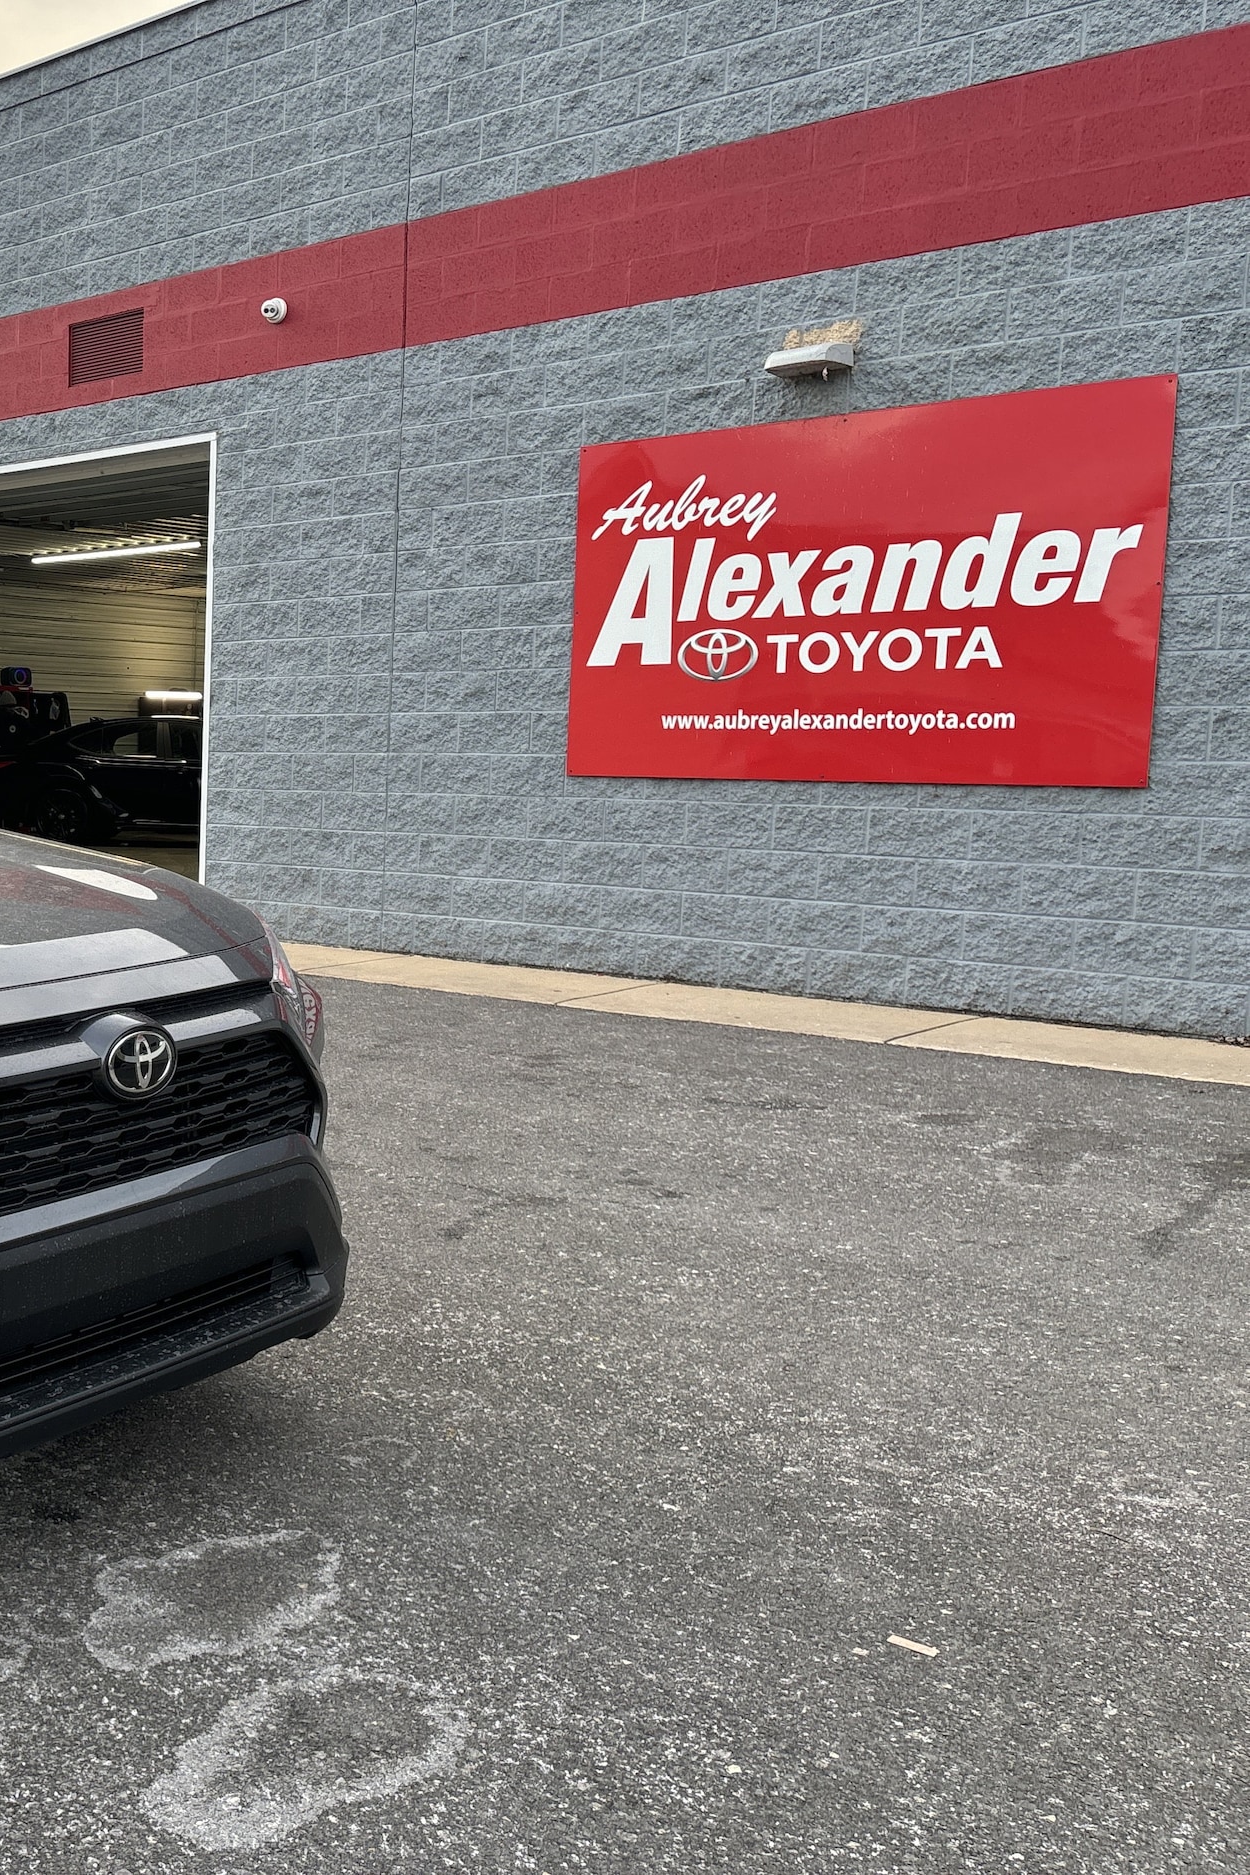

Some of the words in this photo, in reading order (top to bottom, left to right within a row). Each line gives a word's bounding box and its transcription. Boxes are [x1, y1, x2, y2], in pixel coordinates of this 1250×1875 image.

[591, 474, 777, 541] Aubrey
[586, 511, 1145, 667] Alexander
[767, 626, 1003, 674] TOYOTA
[661, 708, 1016, 735] www.aubreyalexandertoyota.com
